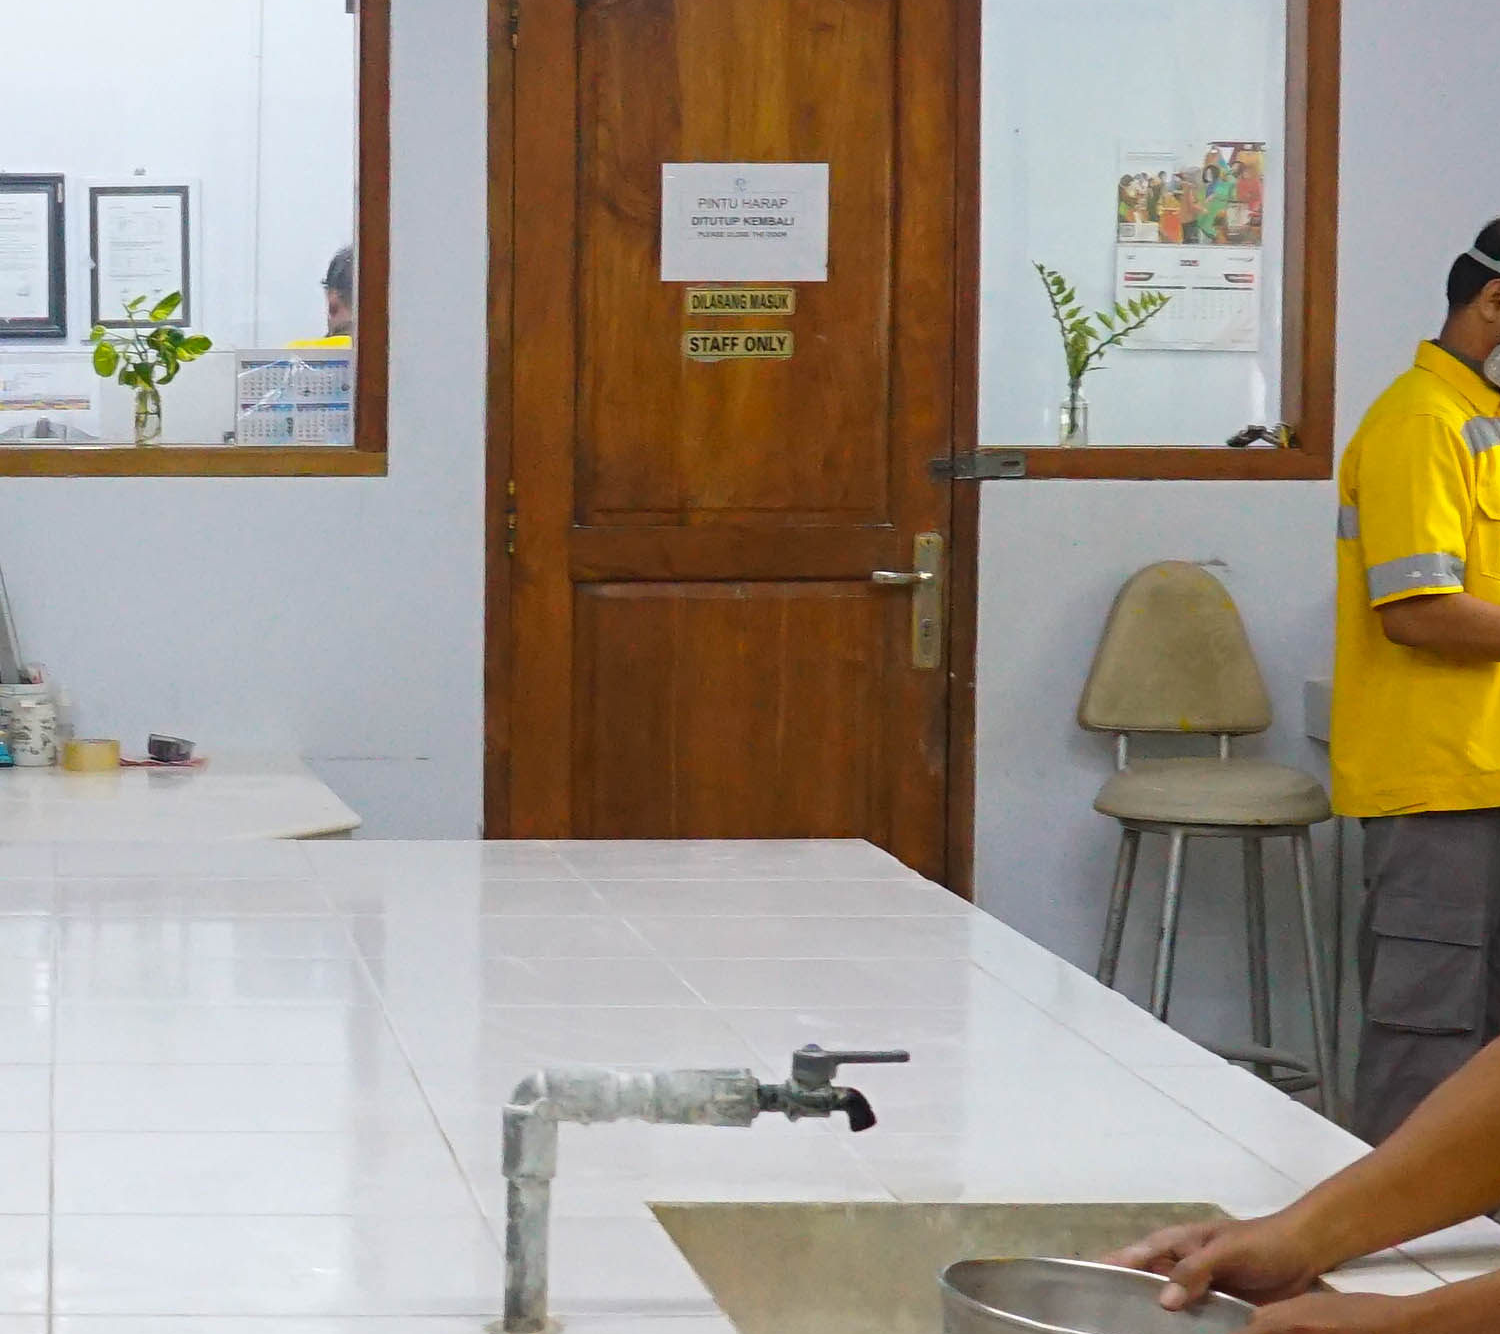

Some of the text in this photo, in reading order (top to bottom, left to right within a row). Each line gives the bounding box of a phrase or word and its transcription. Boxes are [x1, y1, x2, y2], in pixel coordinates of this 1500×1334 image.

[697, 198, 788, 209] PINTU HARAP
[691, 216, 794, 226] DITUTUP KEMBALI
[691, 294, 789, 310] DILARANG MASUK
[690, 336, 787, 353] STAFF ONLY
